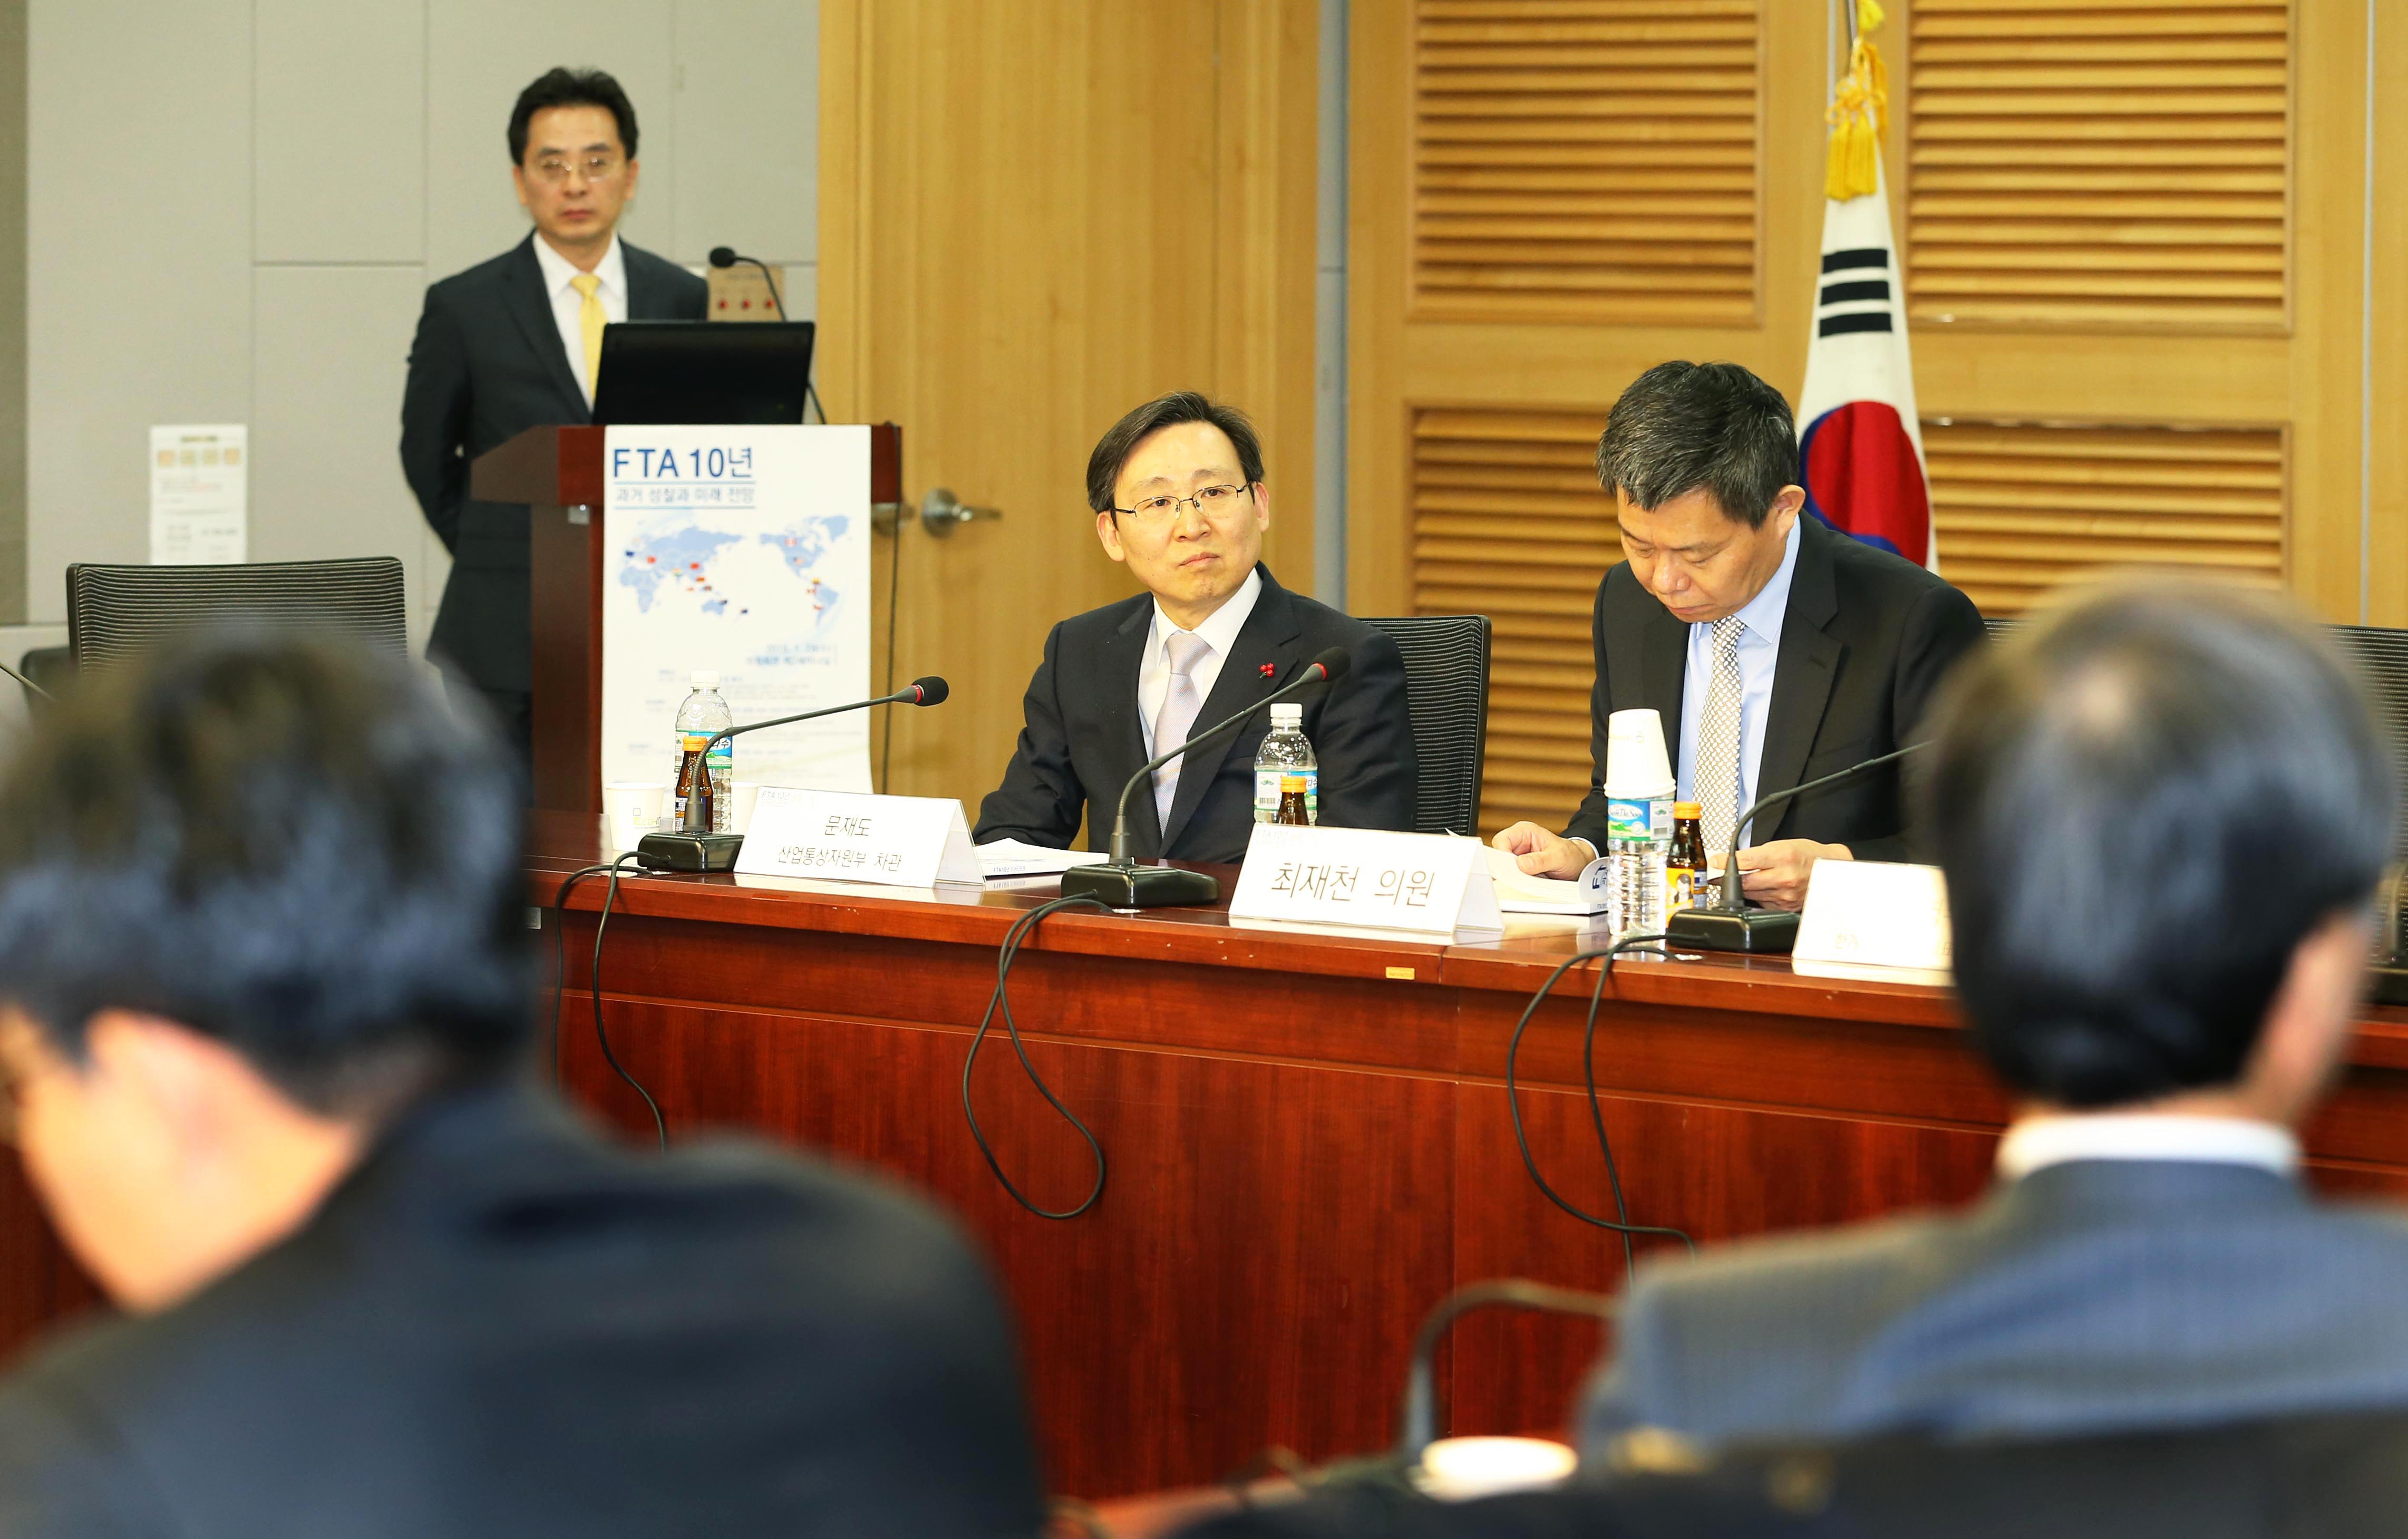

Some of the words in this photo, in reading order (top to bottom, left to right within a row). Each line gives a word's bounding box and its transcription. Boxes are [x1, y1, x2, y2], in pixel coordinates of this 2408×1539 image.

[614, 448, 678, 478] FTA
[690, 447, 752, 478] 10년
[616, 488, 643, 502] 과거
[824, 816, 872, 837] 문재도
[778, 847, 867, 868] 산업통상자원부
[873, 851, 902, 872] 차관
[1271, 863, 1359, 901] 최재천
[1374, 869, 1435, 907] 의원
